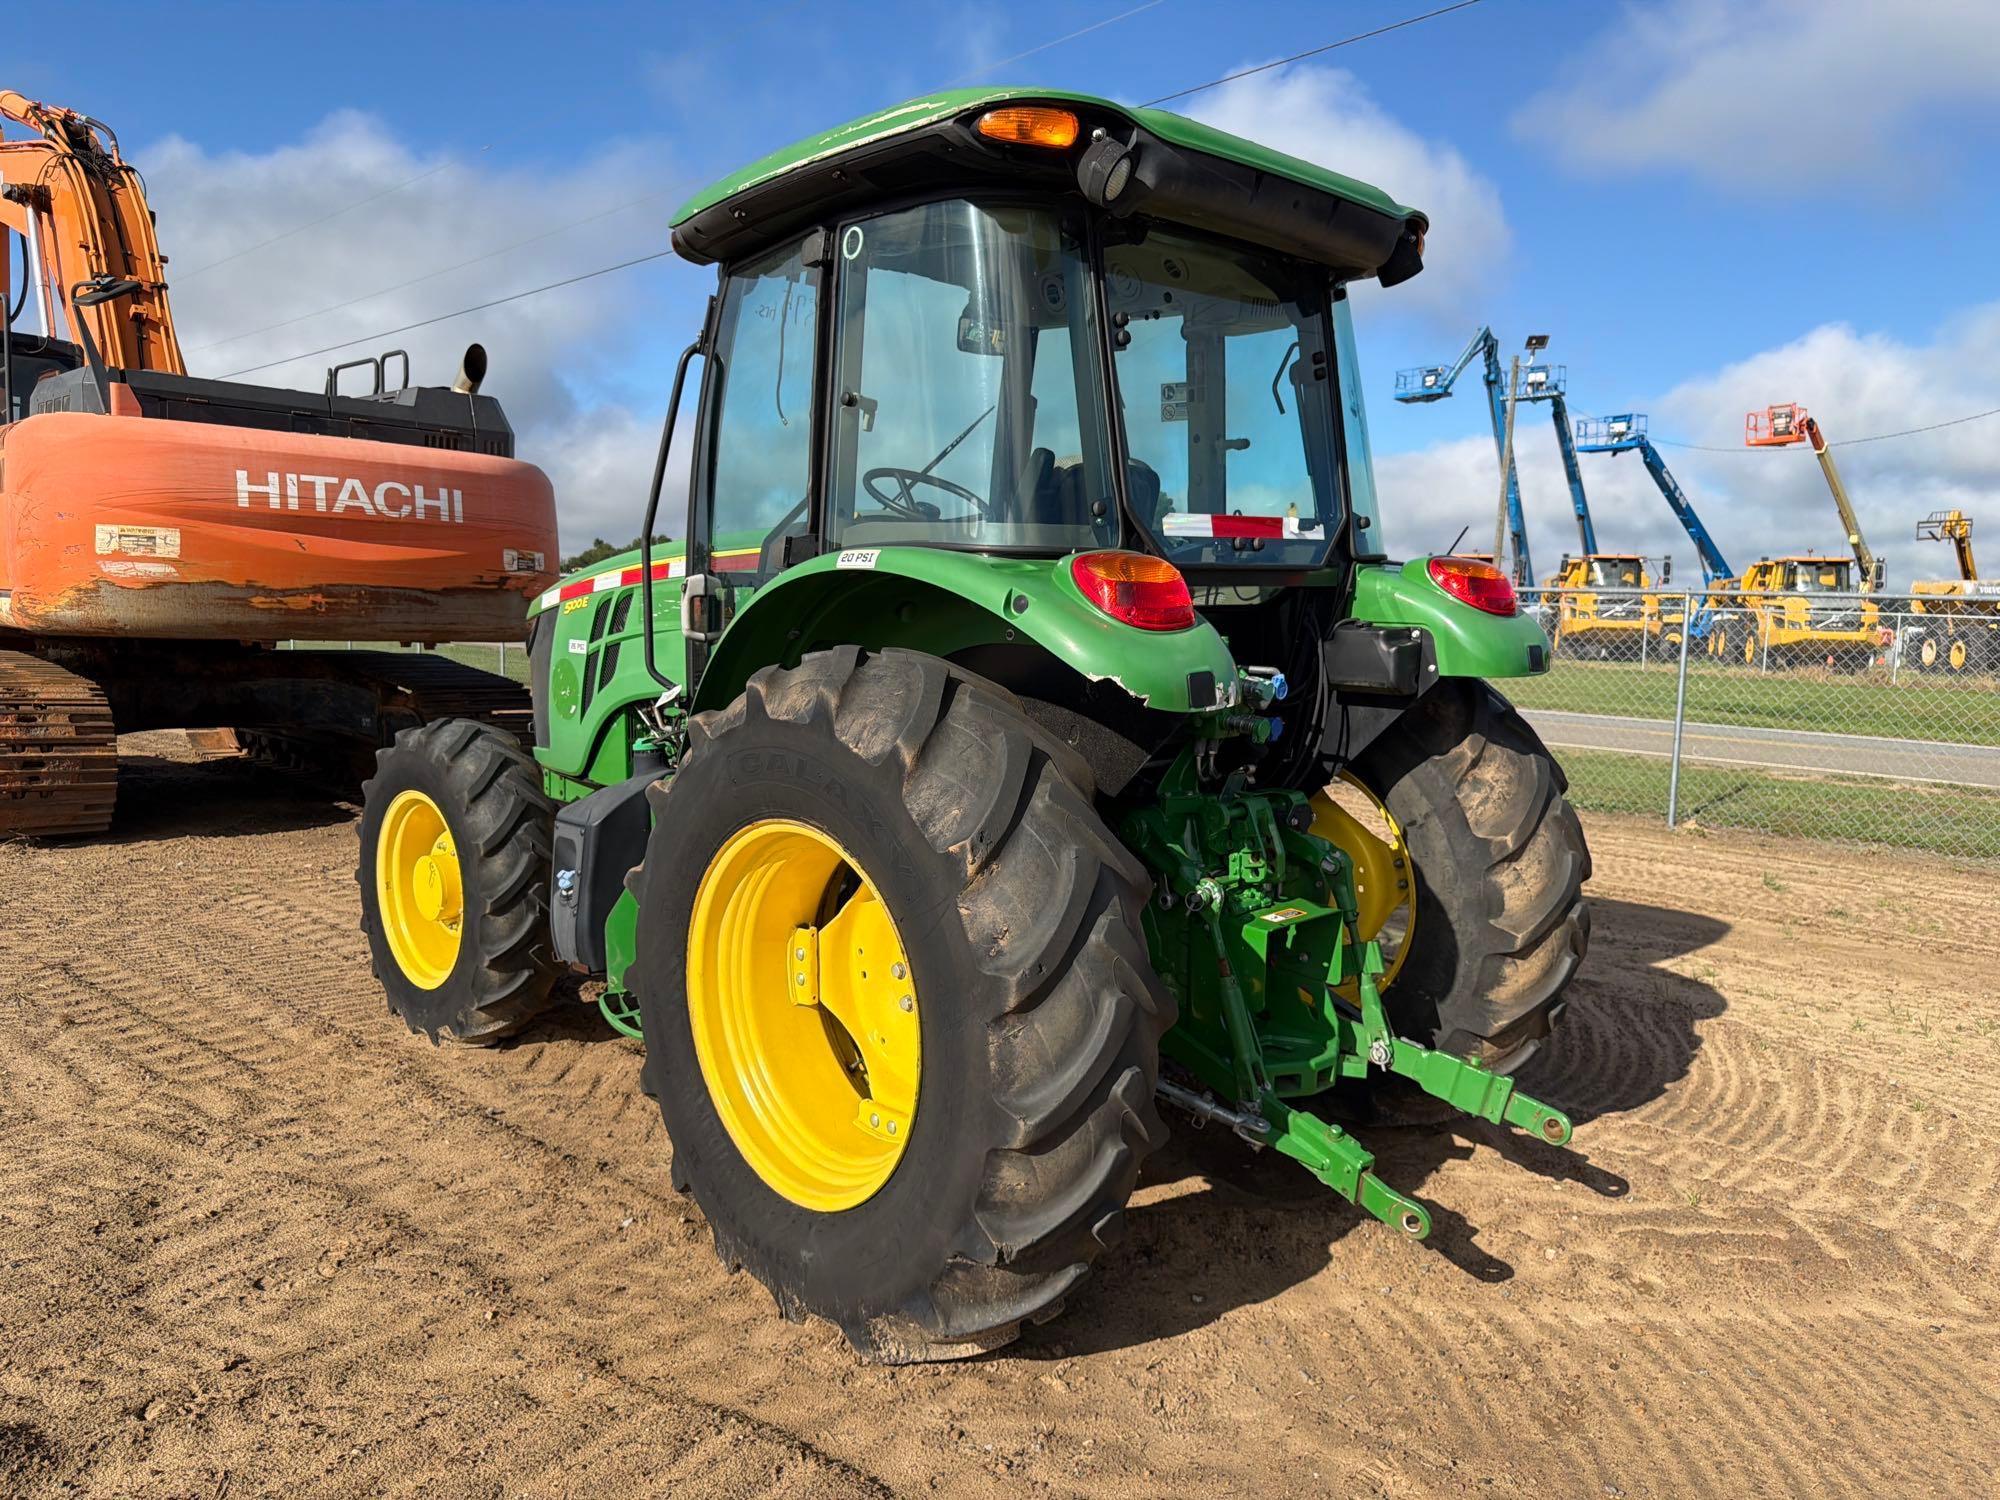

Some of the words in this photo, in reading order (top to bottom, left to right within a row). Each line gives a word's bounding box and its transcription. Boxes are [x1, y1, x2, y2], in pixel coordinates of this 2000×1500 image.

[236, 469, 464, 523] HITACHI
[841, 553, 855, 562] 20
[855, 553, 875, 562] PSI
[742, 751, 916, 882] GALAXY
